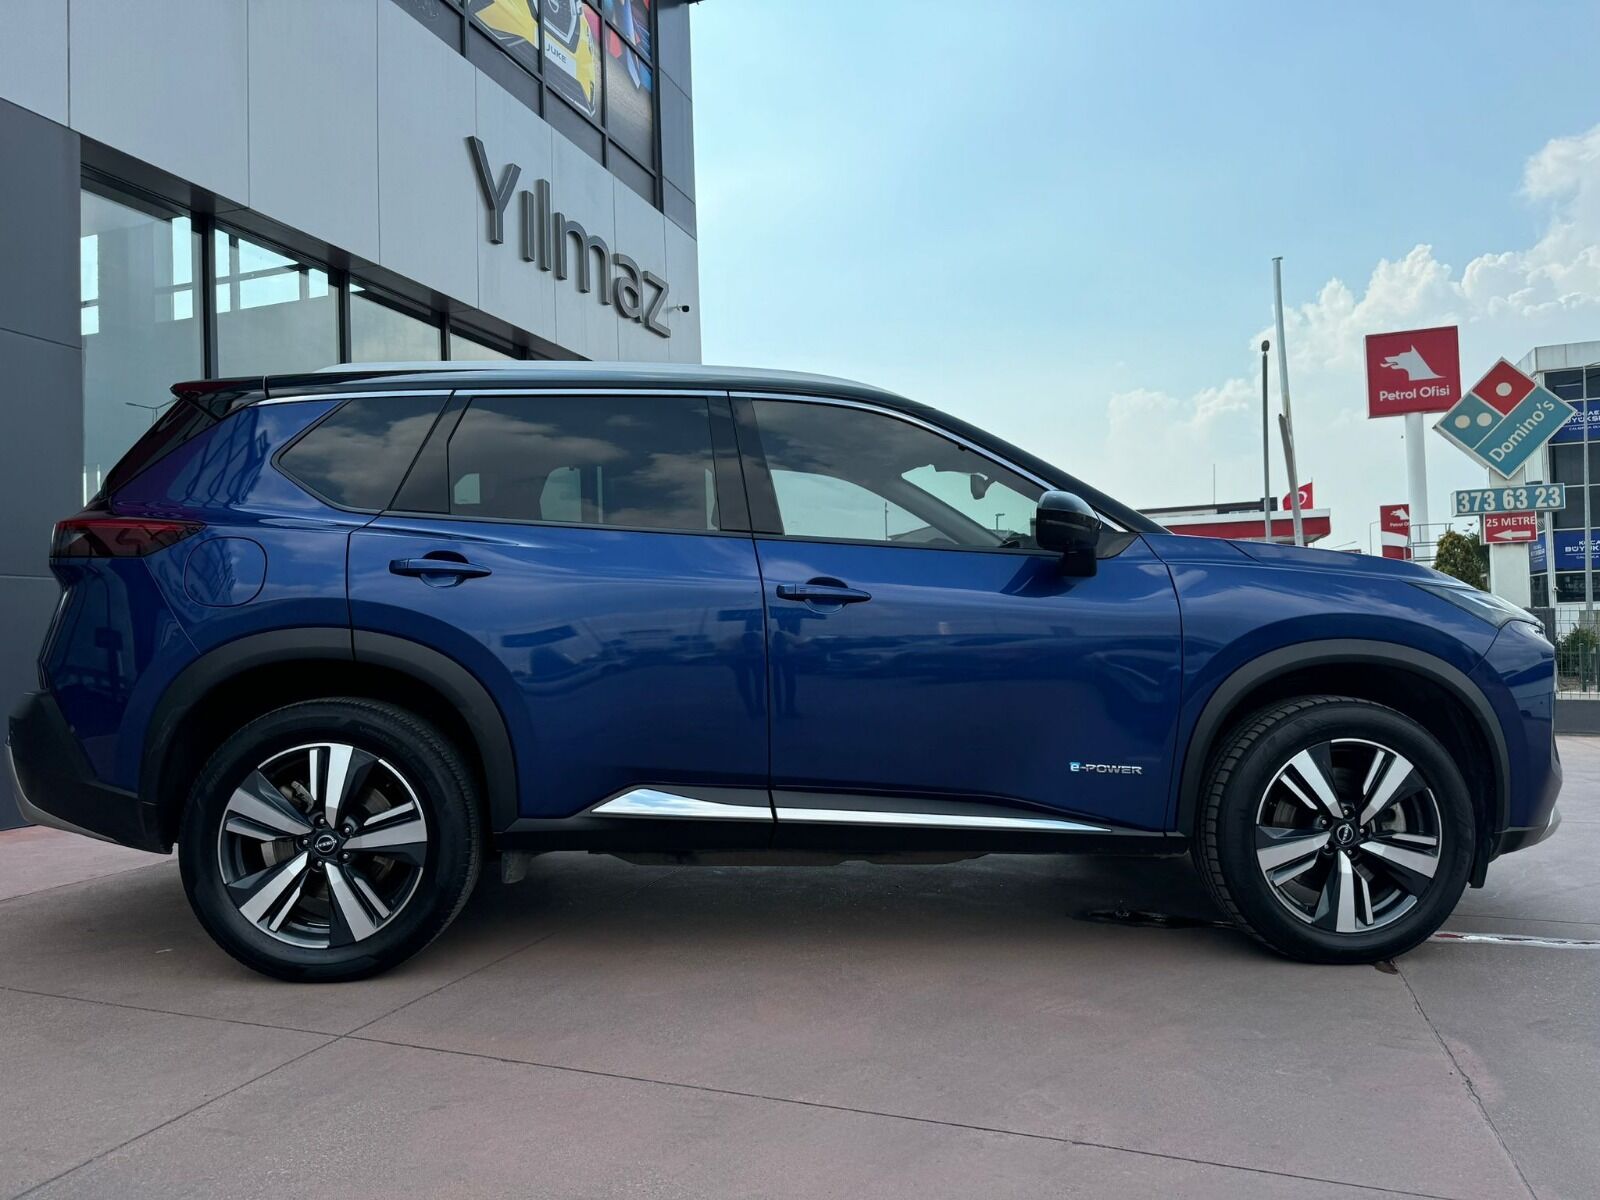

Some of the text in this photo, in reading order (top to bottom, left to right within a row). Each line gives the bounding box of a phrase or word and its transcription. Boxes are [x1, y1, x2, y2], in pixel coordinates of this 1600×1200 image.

[546, 43, 568, 64] JUKE
[467, 135, 671, 338] Yılmaz
[1379, 385, 1450, 402] Petrol Ofisi
[1488, 400, 1555, 462] Domino's
[1458, 486, 1561, 512] 373 63 23
[1486, 515, 1536, 527] 25 METRE
